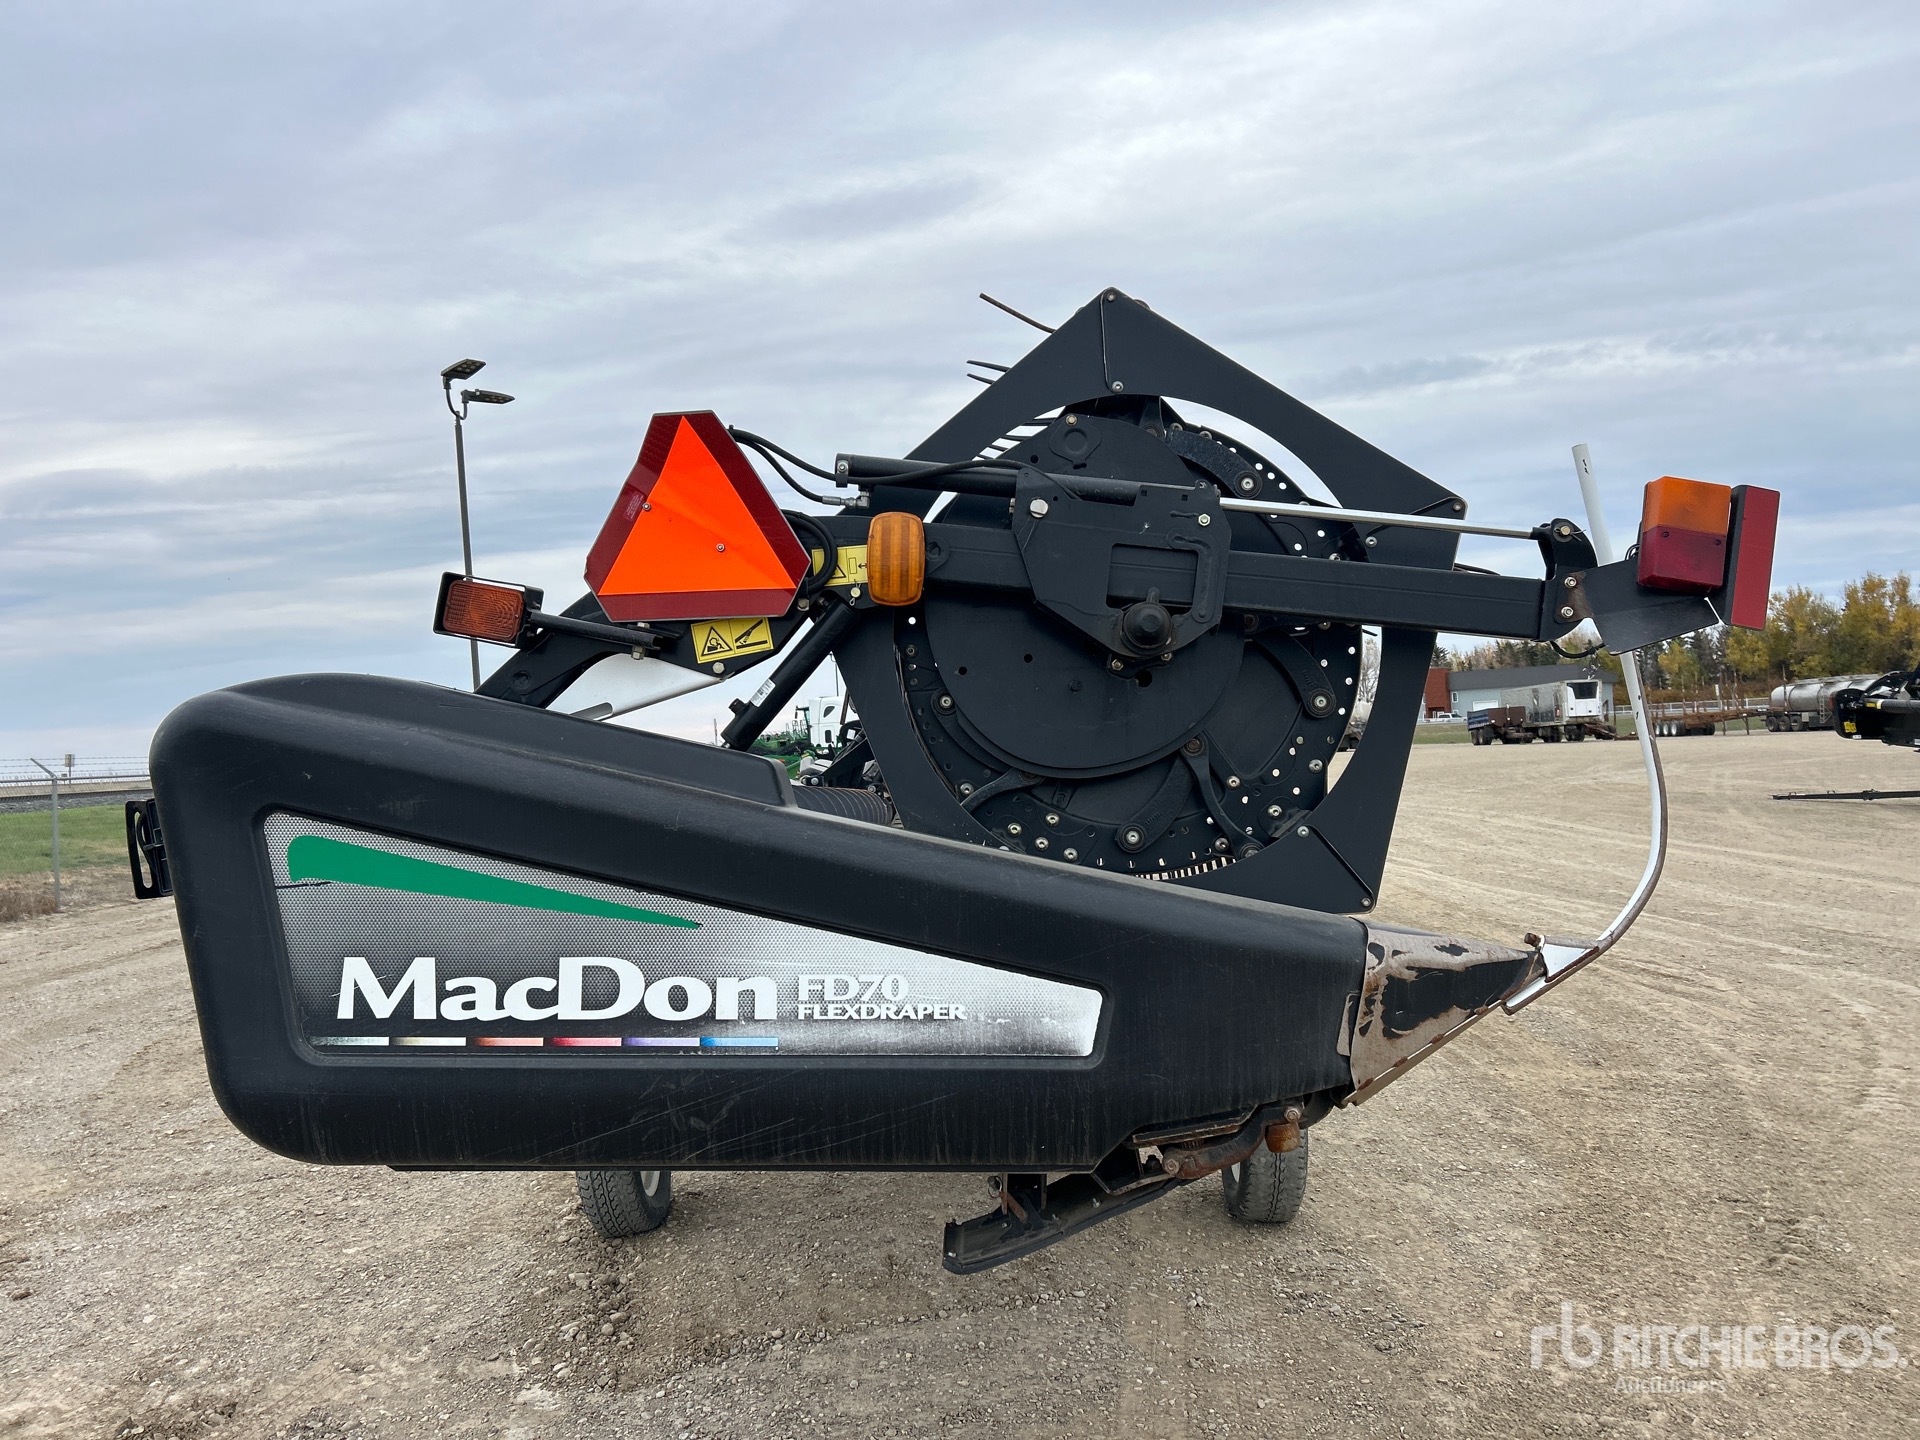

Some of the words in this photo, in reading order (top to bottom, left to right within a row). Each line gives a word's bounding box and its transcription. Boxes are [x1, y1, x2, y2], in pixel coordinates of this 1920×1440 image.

[337, 956, 778, 1021] MacDon
[798, 974, 910, 1001] FD70
[797, 1003, 968, 1020] FLEXDRAPER
